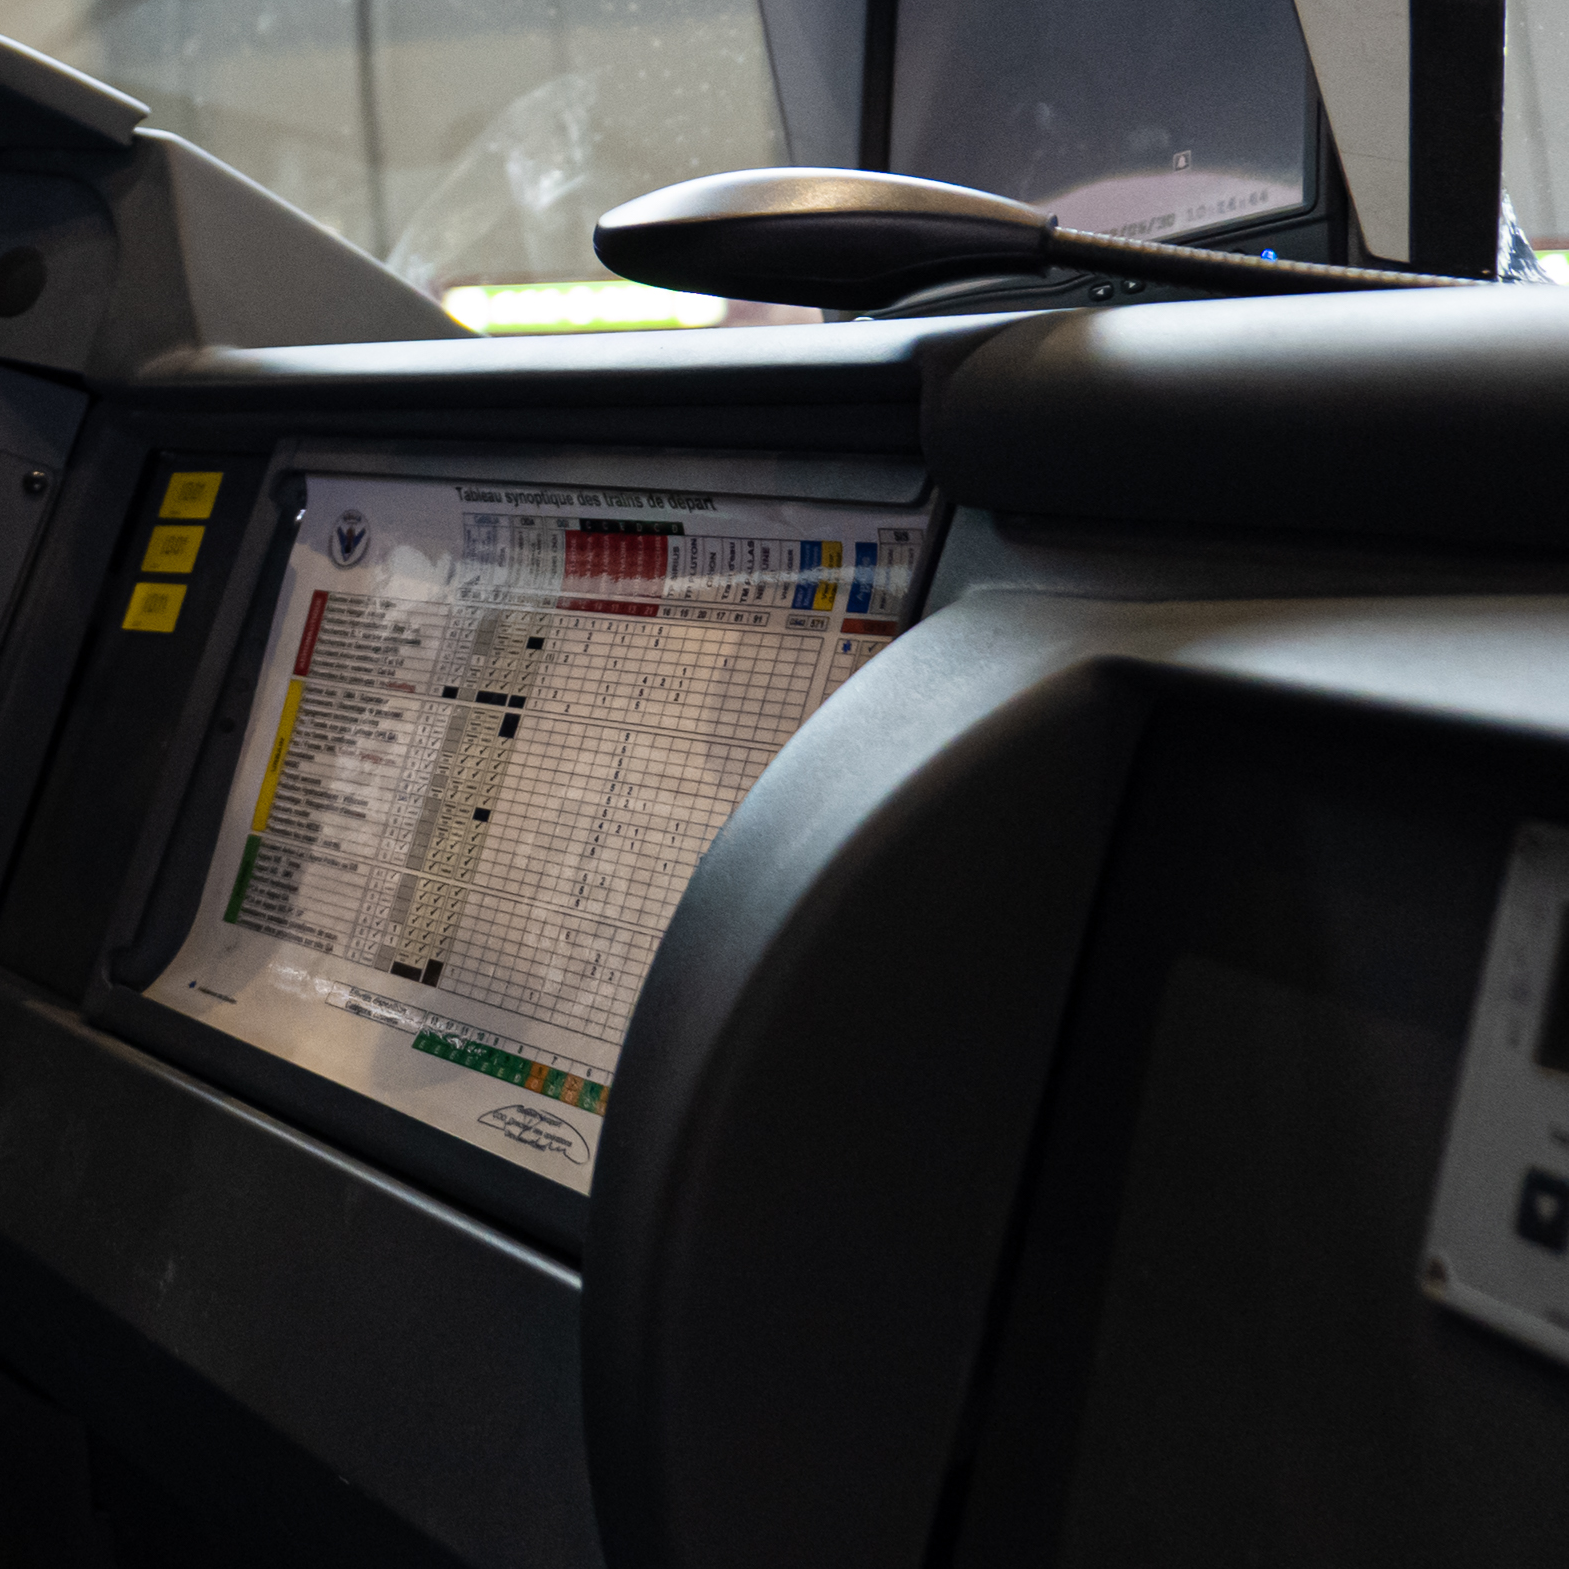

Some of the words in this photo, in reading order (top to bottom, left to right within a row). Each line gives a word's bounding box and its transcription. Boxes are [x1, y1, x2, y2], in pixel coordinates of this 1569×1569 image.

[455, 486, 502, 504] Tableau
[505, 488, 574, 508] synoptique
[577, 490, 601, 507] des
[603, 492, 644, 509] trains
[648, 494, 665, 509] de
[667, 494, 717, 512] départ
